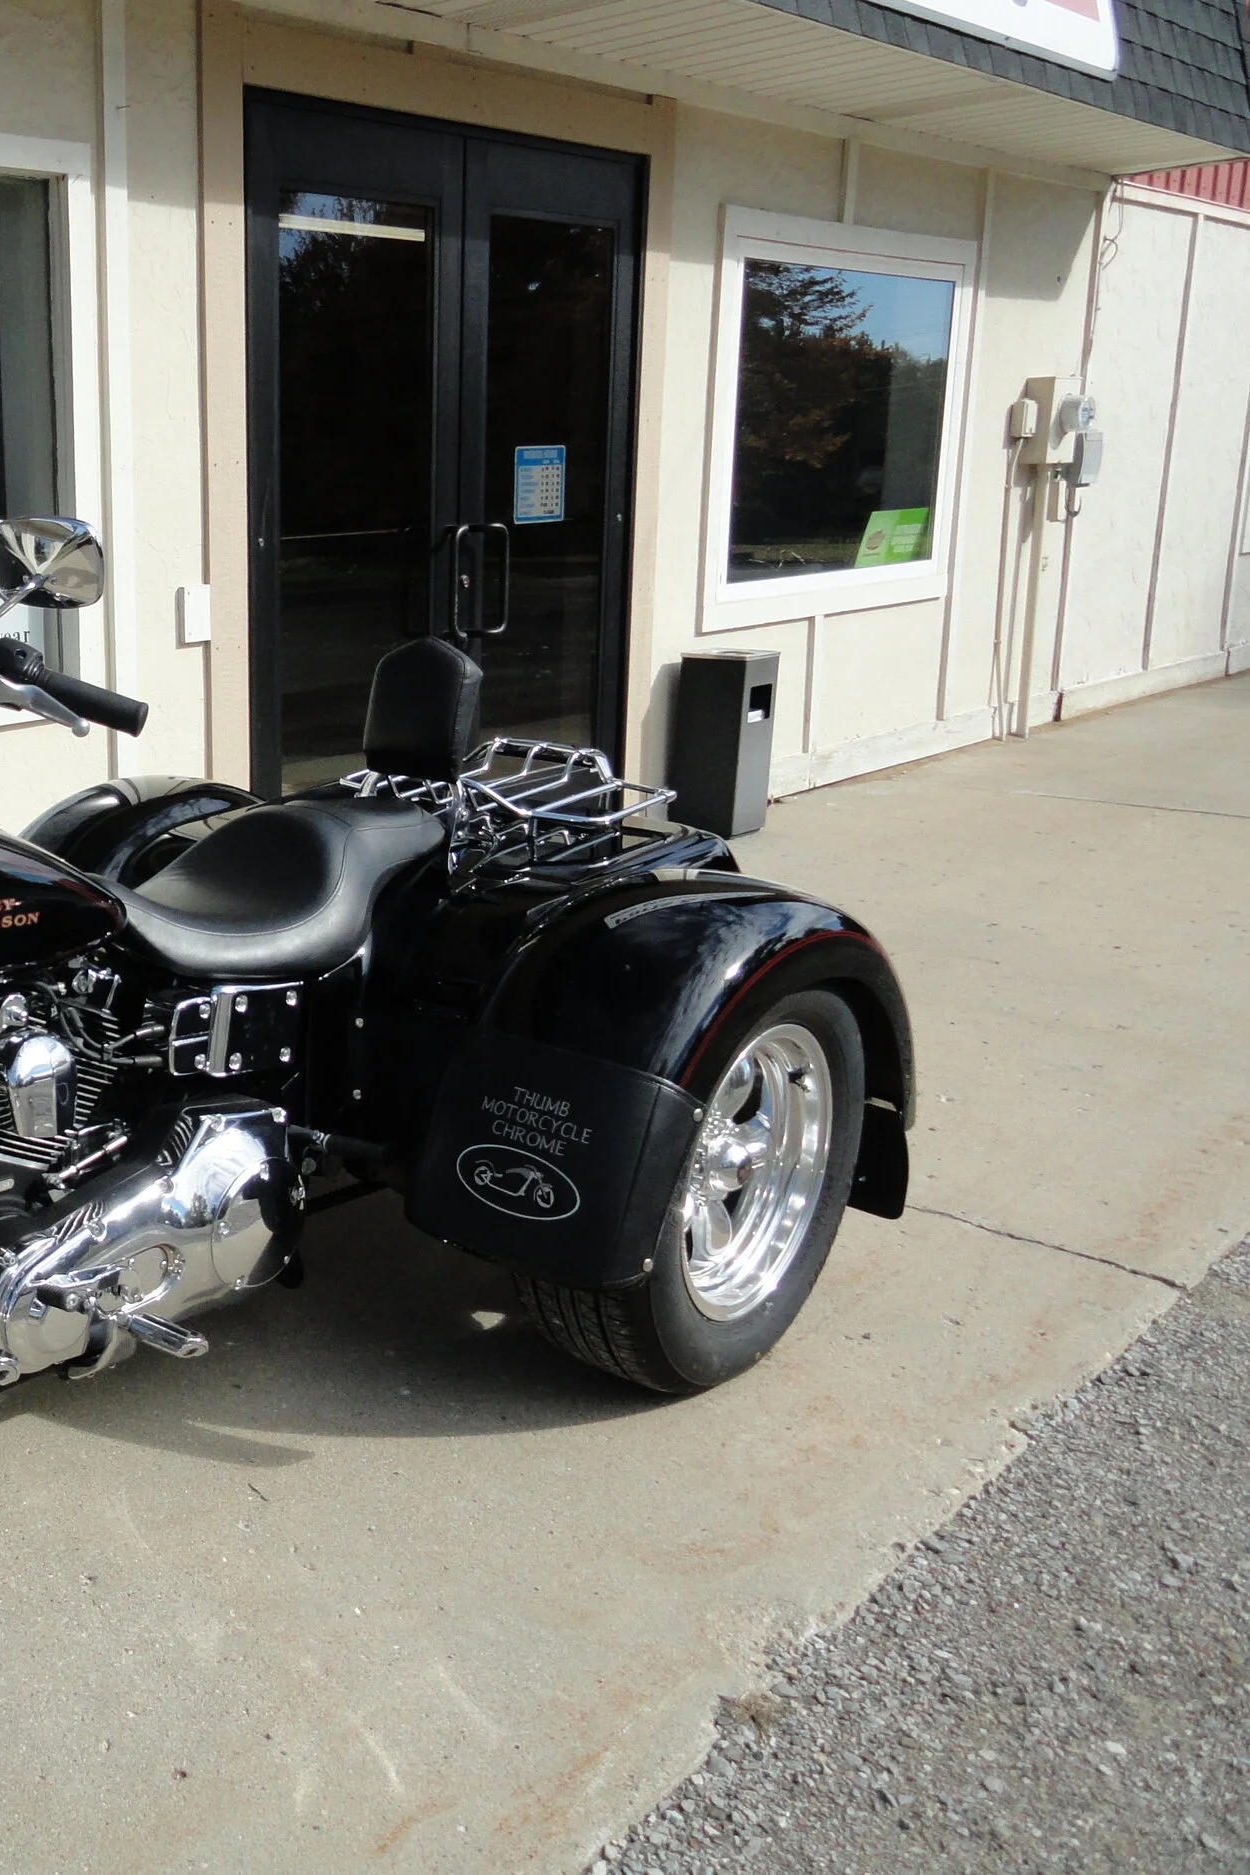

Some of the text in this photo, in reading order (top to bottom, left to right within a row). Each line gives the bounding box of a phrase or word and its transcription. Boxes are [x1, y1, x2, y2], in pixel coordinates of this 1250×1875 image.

[514, 1086, 571, 1117] THUMB
[481, 1096, 593, 1144] MOTORCYCLE
[492, 1120, 567, 1156] CHROME
